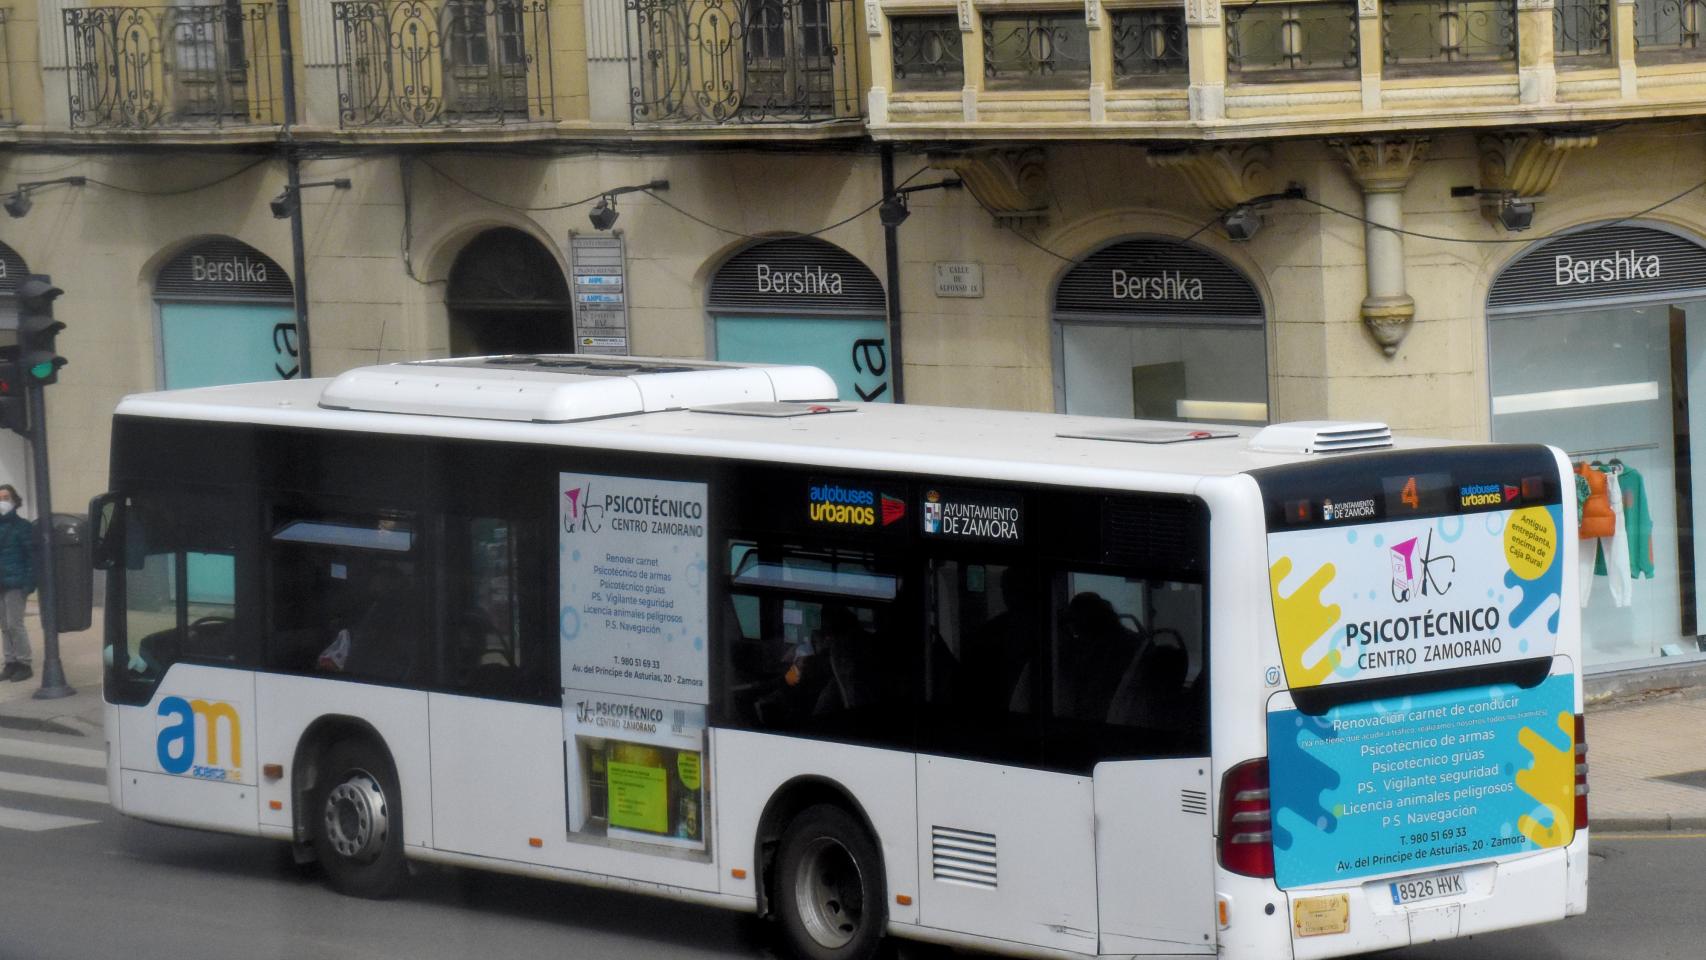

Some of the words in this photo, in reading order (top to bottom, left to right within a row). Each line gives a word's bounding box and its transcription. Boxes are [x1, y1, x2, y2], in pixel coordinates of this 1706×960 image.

[192, 255, 267, 282] Bershka
[949, 265, 969, 273] CALLE
[1555, 249, 1660, 286] Bershka
[757, 263, 842, 294] Bershka
[1111, 269, 1204, 300] Bershka
[810, 484, 874, 505] autobuses
[1401, 476, 1420, 510] 4
[1460, 484, 1499, 496] autobuses
[1461, 492, 1501, 507] urbanos
[605, 494, 702, 519] PSICOTÉCNICO
[810, 500, 875, 526] urbanos
[943, 503, 1019, 522] AYUNTAMIENTO
[1334, 499, 1375, 510] AYUNTAMIENTO
[1334, 509, 1343, 519] DE
[1344, 506, 1375, 518] ZAMORA
[612, 518, 648, 533] CENTRO
[651, 521, 703, 538] ZAMORANO
[943, 516, 959, 534] DE
[961, 518, 1019, 540] ZAMORA
[1520, 514, 1547, 533] Antigua
[1509, 545, 1524, 558] Caja
[1525, 553, 1543, 568] Rural
[1511, 536, 1536, 553] encima
[1536, 548, 1546, 558] de
[606, 553, 634, 564] Renovar
[635, 558, 658, 567] carnet
[639, 570, 648, 579] de
[649, 572, 672, 582] armas
[606, 593, 638, 605] Vigilante
[639, 597, 674, 608] seguridad
[583, 604, 612, 616] Licencia
[613, 608, 645, 619] animales
[646, 612, 683, 624] peligrosos
[1346, 606, 1500, 647] PSICOTÉCNICO
[621, 656, 634, 666] 980
[634, 657, 642, 667] 51
[642, 658, 651, 668] 69
[651, 659, 660, 669] 33
[1358, 647, 1417, 670] CENTRO
[1423, 637, 1502, 662] ZAMORANO
[571, 663, 583, 673] Av.
[583, 665, 594, 674] del
[624, 669, 633, 679] de
[633, 670, 663, 683] Asturias,
[663, 673, 672, 683] 20
[677, 675, 703, 687] Zamora
[596, 701, 663, 722] PSICOTÉCNICO
[1408, 706, 1447, 722] carnet
[1450, 703, 1466, 716] de
[1468, 695, 1520, 714] conducir
[157, 696, 241, 774] am
[596, 716, 621, 729] CENTRO
[623, 719, 657, 734] ZAMORANO
[1325, 736, 1345, 745] tiene
[1346, 735, 1361, 744] que
[1440, 734, 1456, 746] de
[1458, 729, 1496, 744] armas
[1383, 773, 1437, 792] Vigilante
[1439, 763, 1499, 784] seguridad
[1342, 798, 1393, 816] Licencia
[1396, 790, 1450, 807] animales
[1453, 782, 1514, 801] peligrosos
[1400, 835, 1408, 846] T.
[1410, 832, 1428, 845] 980
[1430, 830, 1440, 842] 51
[1442, 828, 1454, 840] 69
[1455, 826, 1467, 838] 33
[1337, 860, 1352, 871] Av.
[1354, 858, 1370, 868] del
[1415, 848, 1427, 859] de
[1429, 843, 1470, 857] Asturias,
[1472, 839, 1484, 851] 20
[1490, 835, 1526, 848] Zamora
[1399, 880, 1434, 901] 8926
[1436, 875, 1463, 894] HVK
